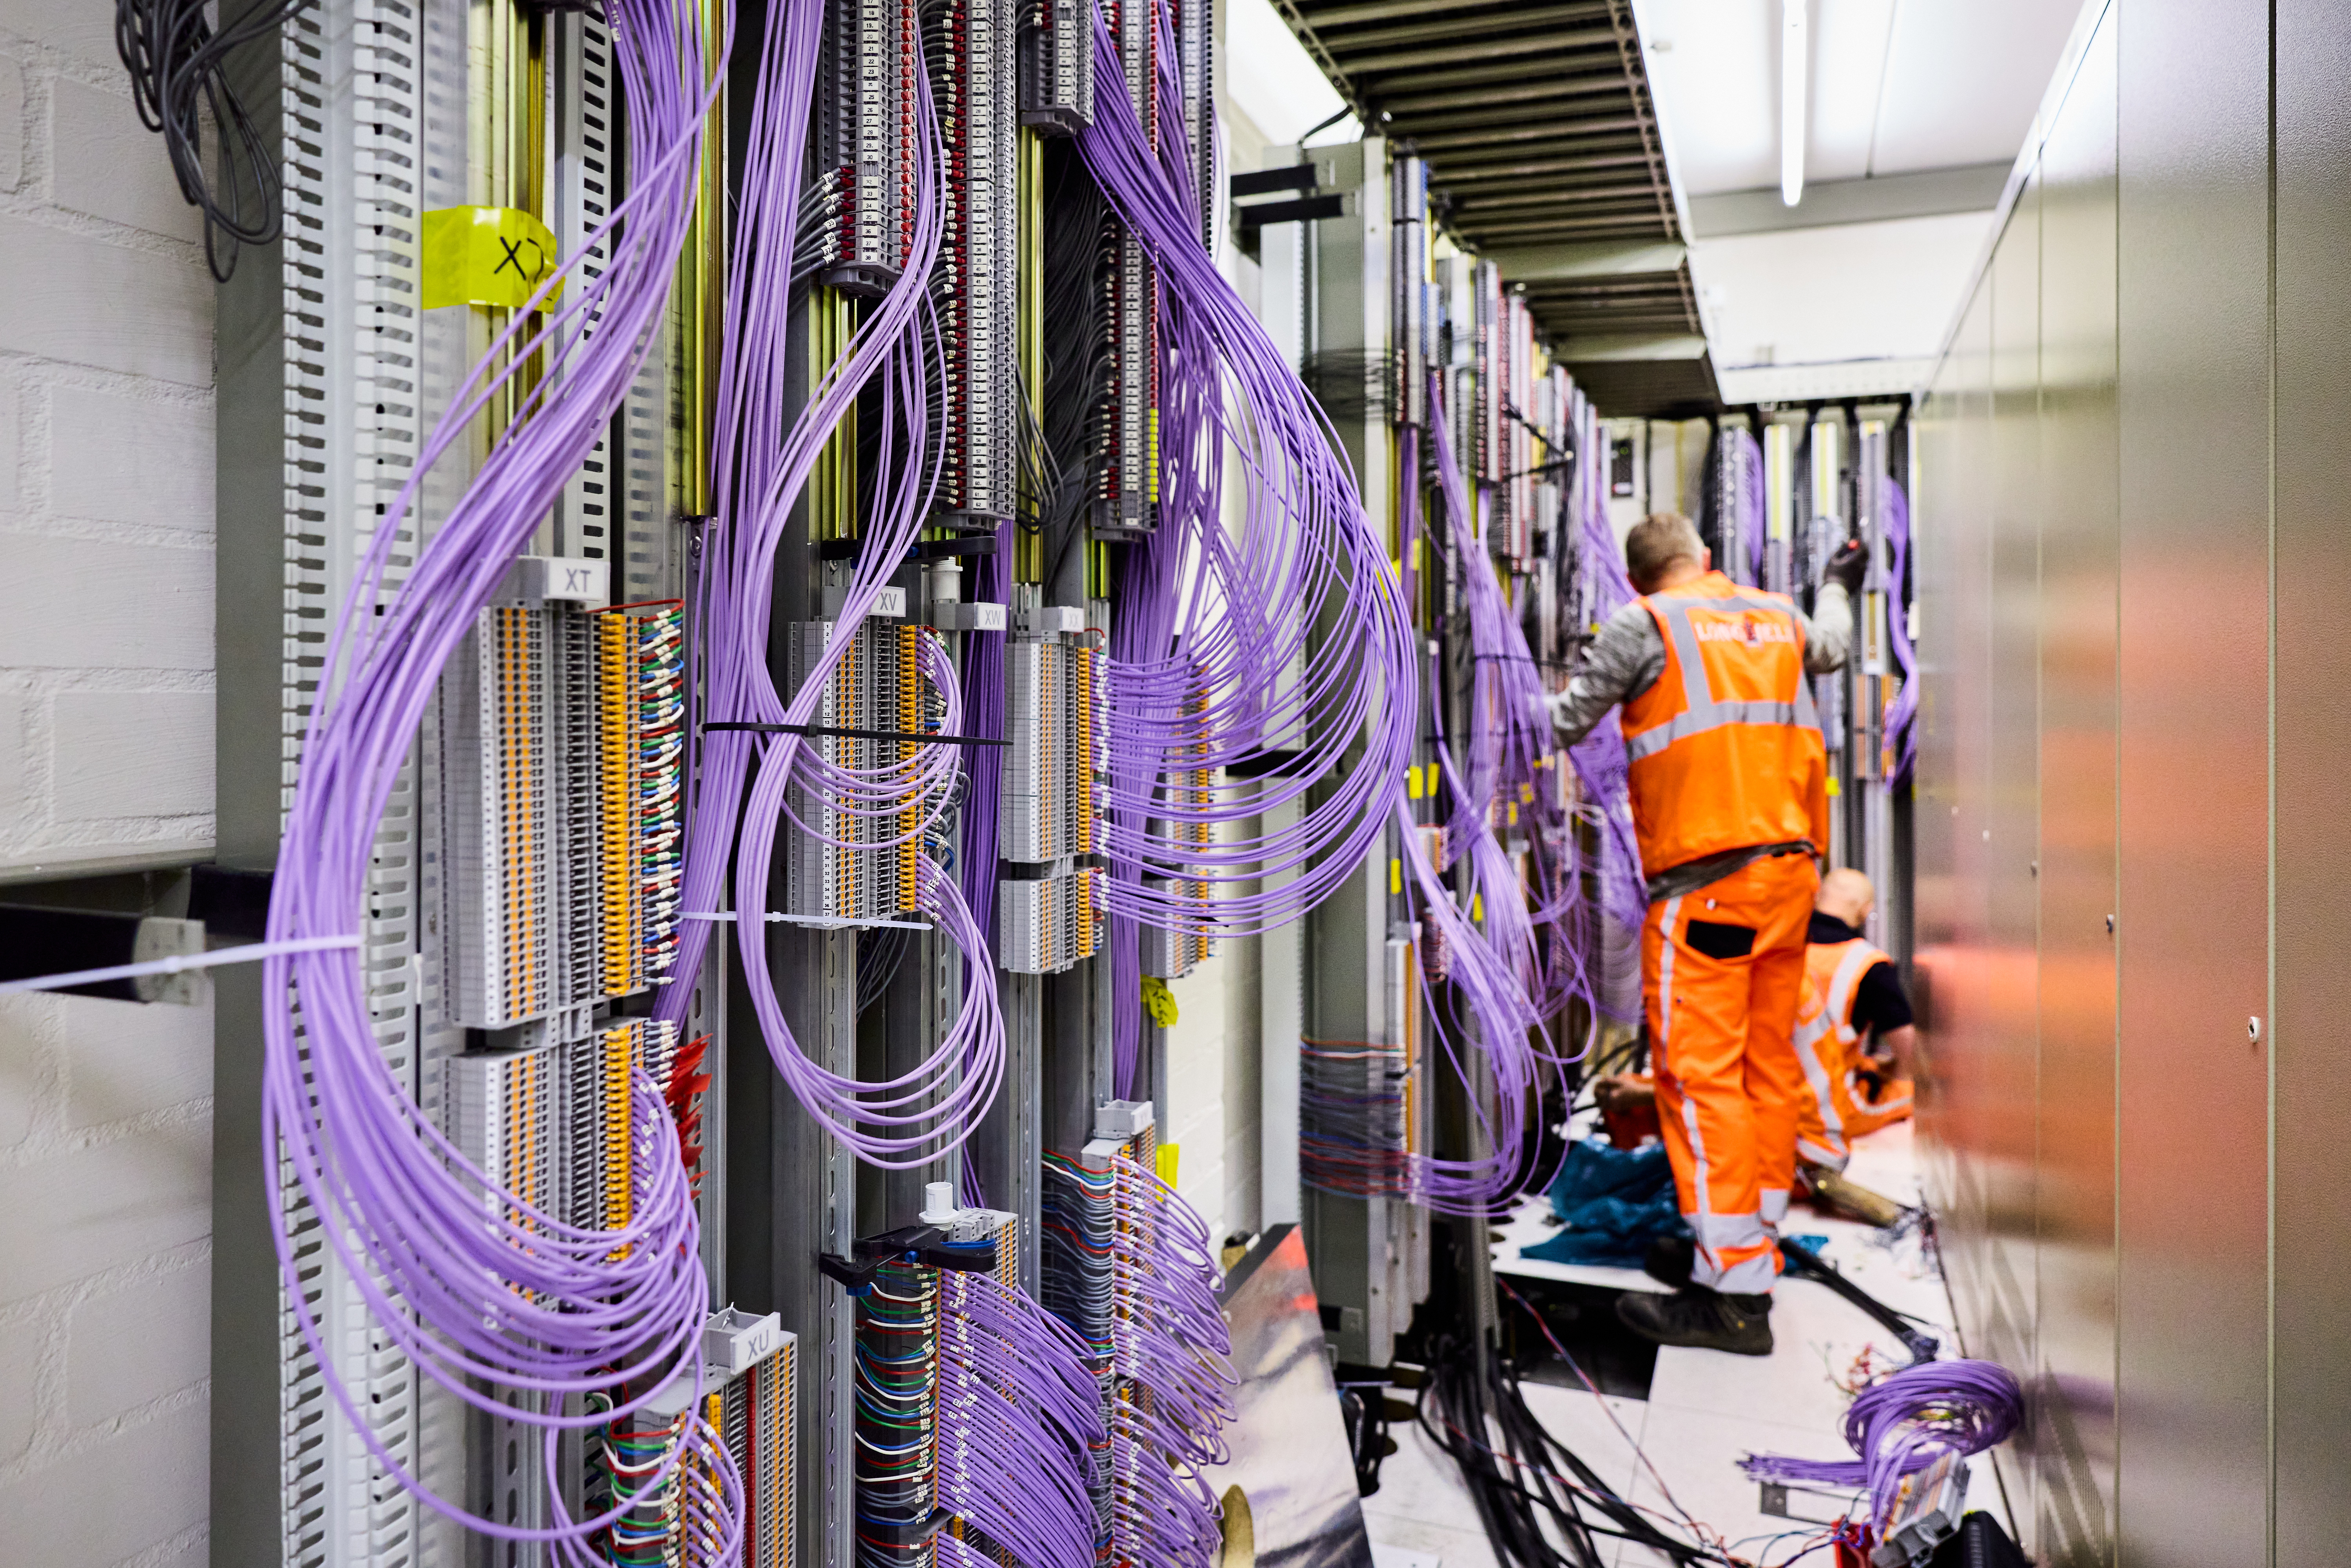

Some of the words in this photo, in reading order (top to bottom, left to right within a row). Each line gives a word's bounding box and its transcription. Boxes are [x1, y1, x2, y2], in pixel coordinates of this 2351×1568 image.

[565, 569, 591, 592] XT
[880, 592, 897, 610] XV
[985, 610, 1001, 625] XW
[748, 1329, 768, 1360] XU
